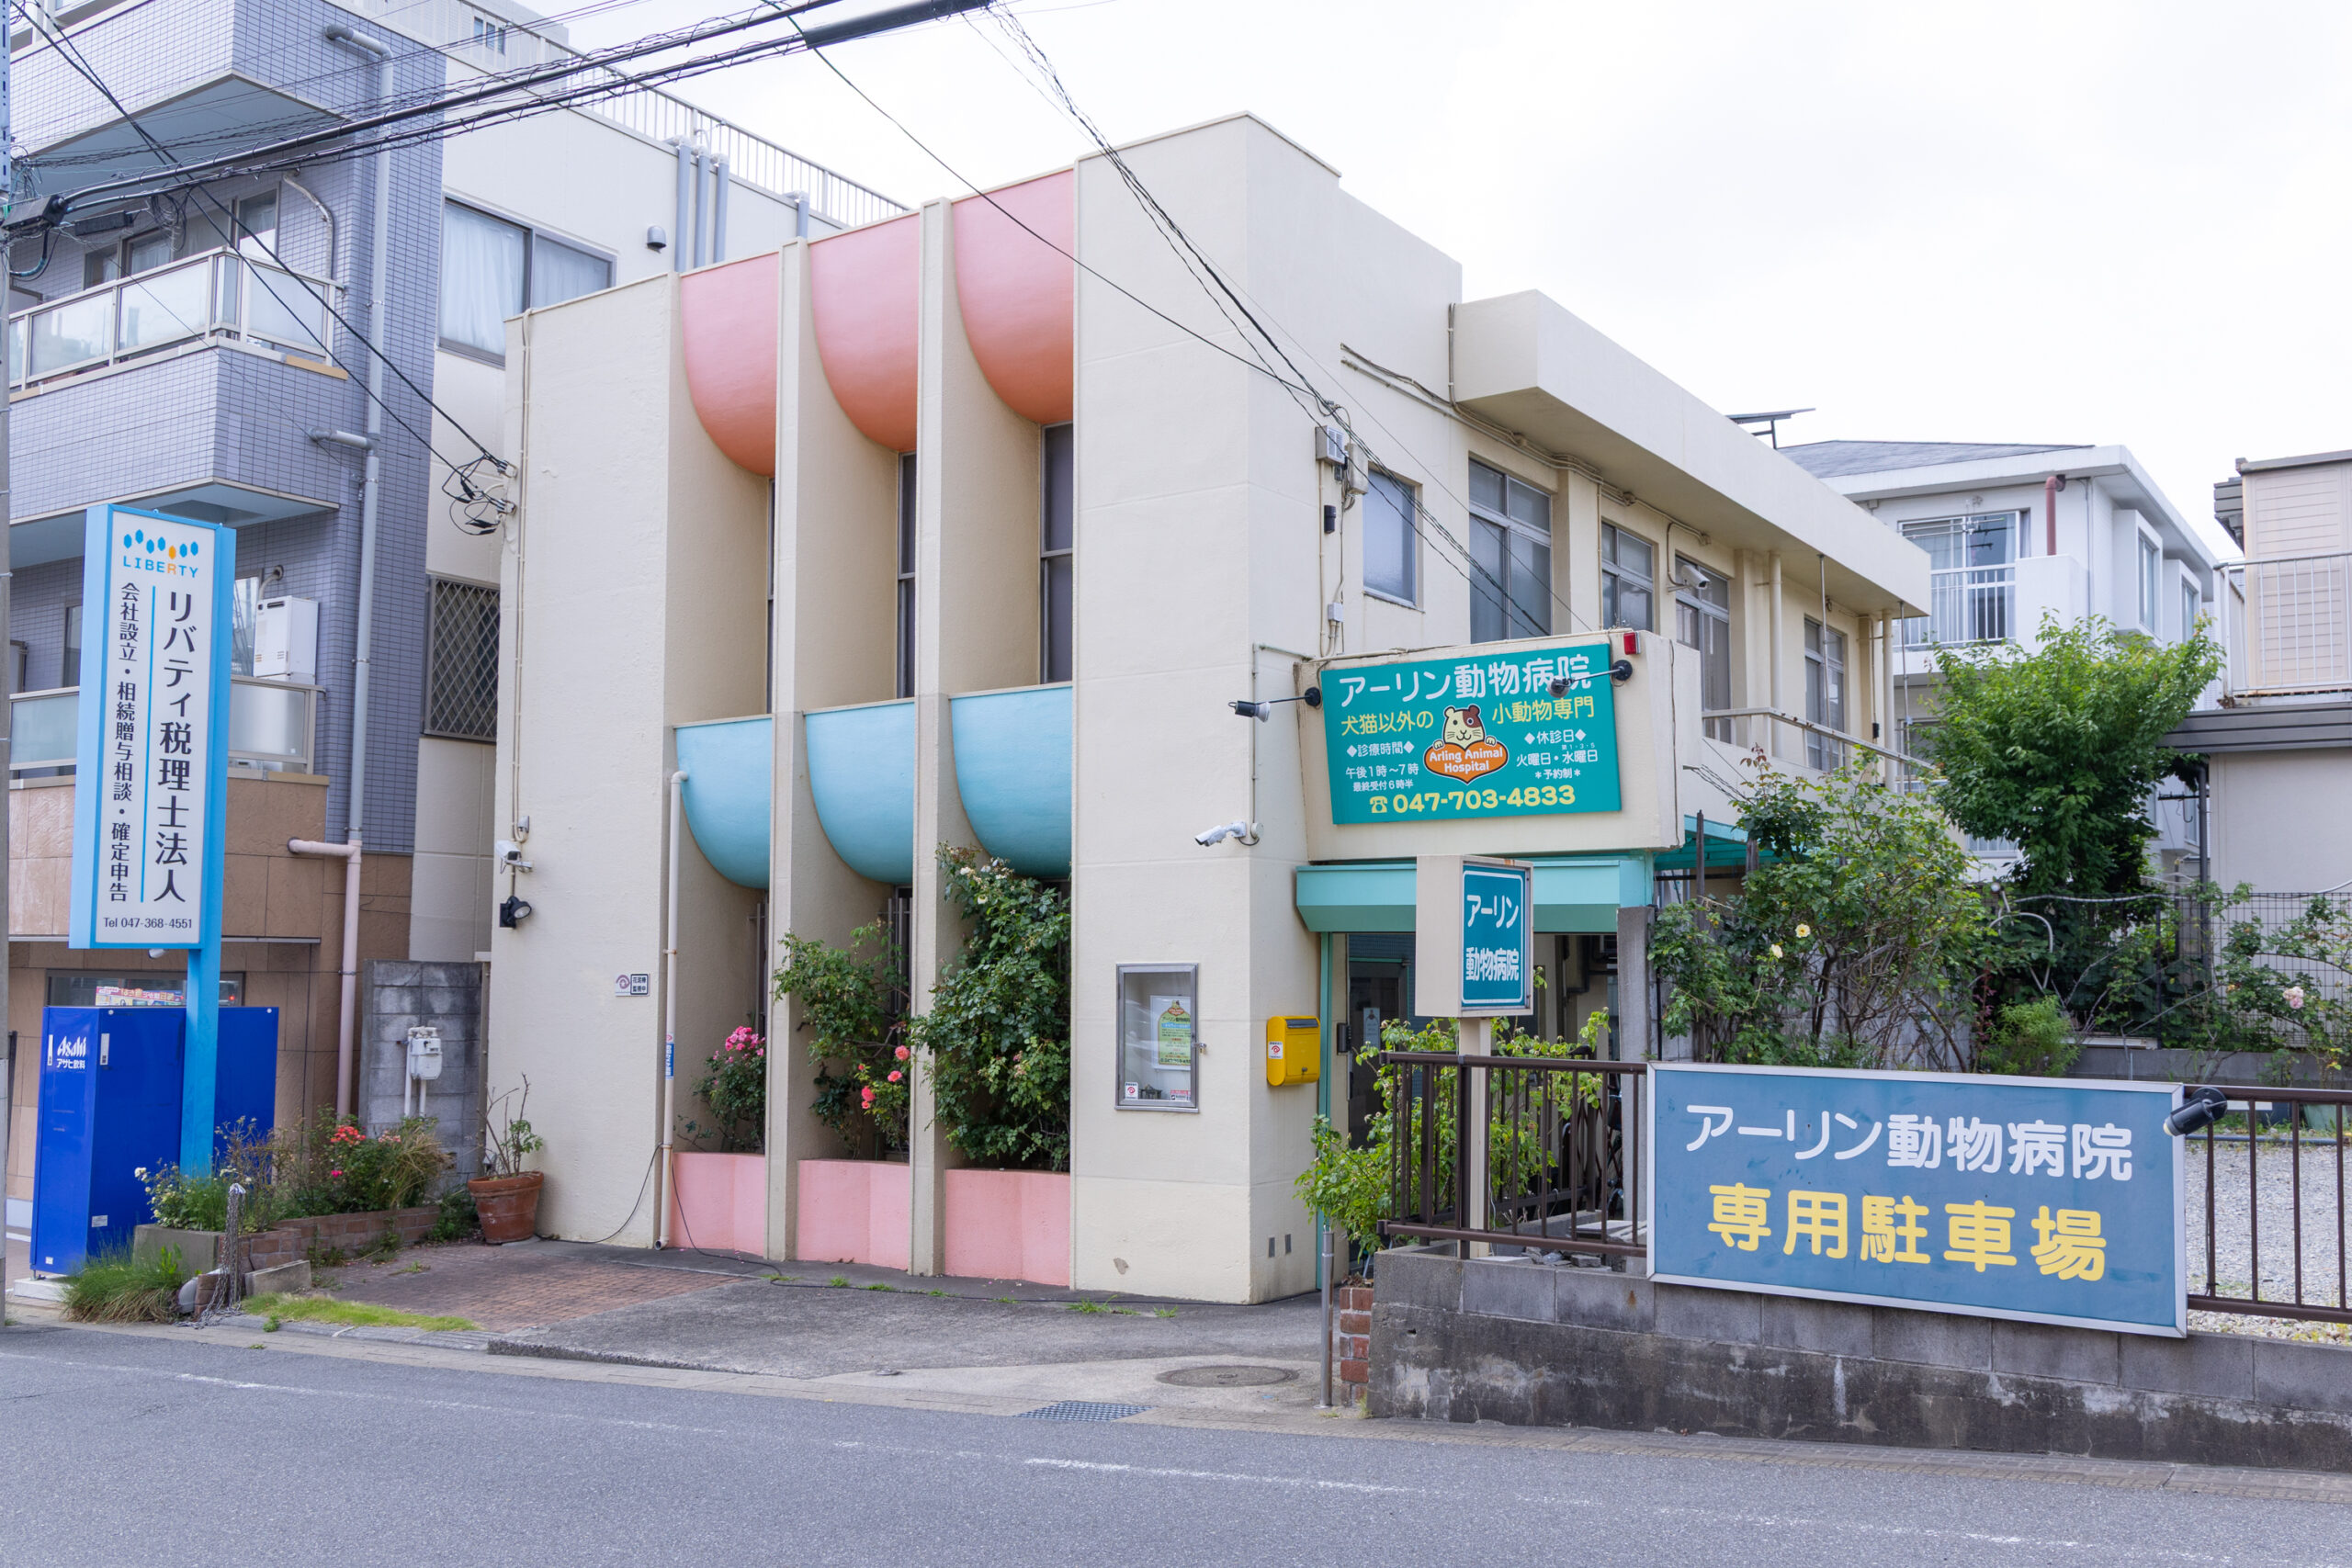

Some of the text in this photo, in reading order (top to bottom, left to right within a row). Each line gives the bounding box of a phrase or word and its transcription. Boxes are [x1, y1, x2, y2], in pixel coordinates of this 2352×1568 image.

[123, 555, 198, 578] LIBERTY
[1339, 653, 1592, 707] アーリン動物病院
[1340, 710, 1434, 737] 犬猫以外の
[1492, 695, 1595, 725] 小動物専門
[109, 582, 140, 902] 会社設立・相続贈与相談・確定申告
[153, 591, 197, 903] リバティ税理士法人
[1429, 747, 1503, 763] Arling Animal
[1444, 761, 1490, 775] Hospital
[1516, 749, 1599, 767] 火曜日・水曜日
[1352, 779, 1414, 793] 最終受付6時半
[1393, 784, 1576, 813] 047-703-4833
[103, 918, 192, 929] Tel 047-368-4551
[1466, 894, 1519, 929] アーリン
[1465, 946, 1520, 982] 動物病院
[57, 1035, 86, 1057] Asahi
[56, 1058, 85, 1069] アサヒ飲料
[1686, 1103, 2132, 1181] アーリン動物病院
[1707, 1181, 2107, 1281] 専用駐車場
